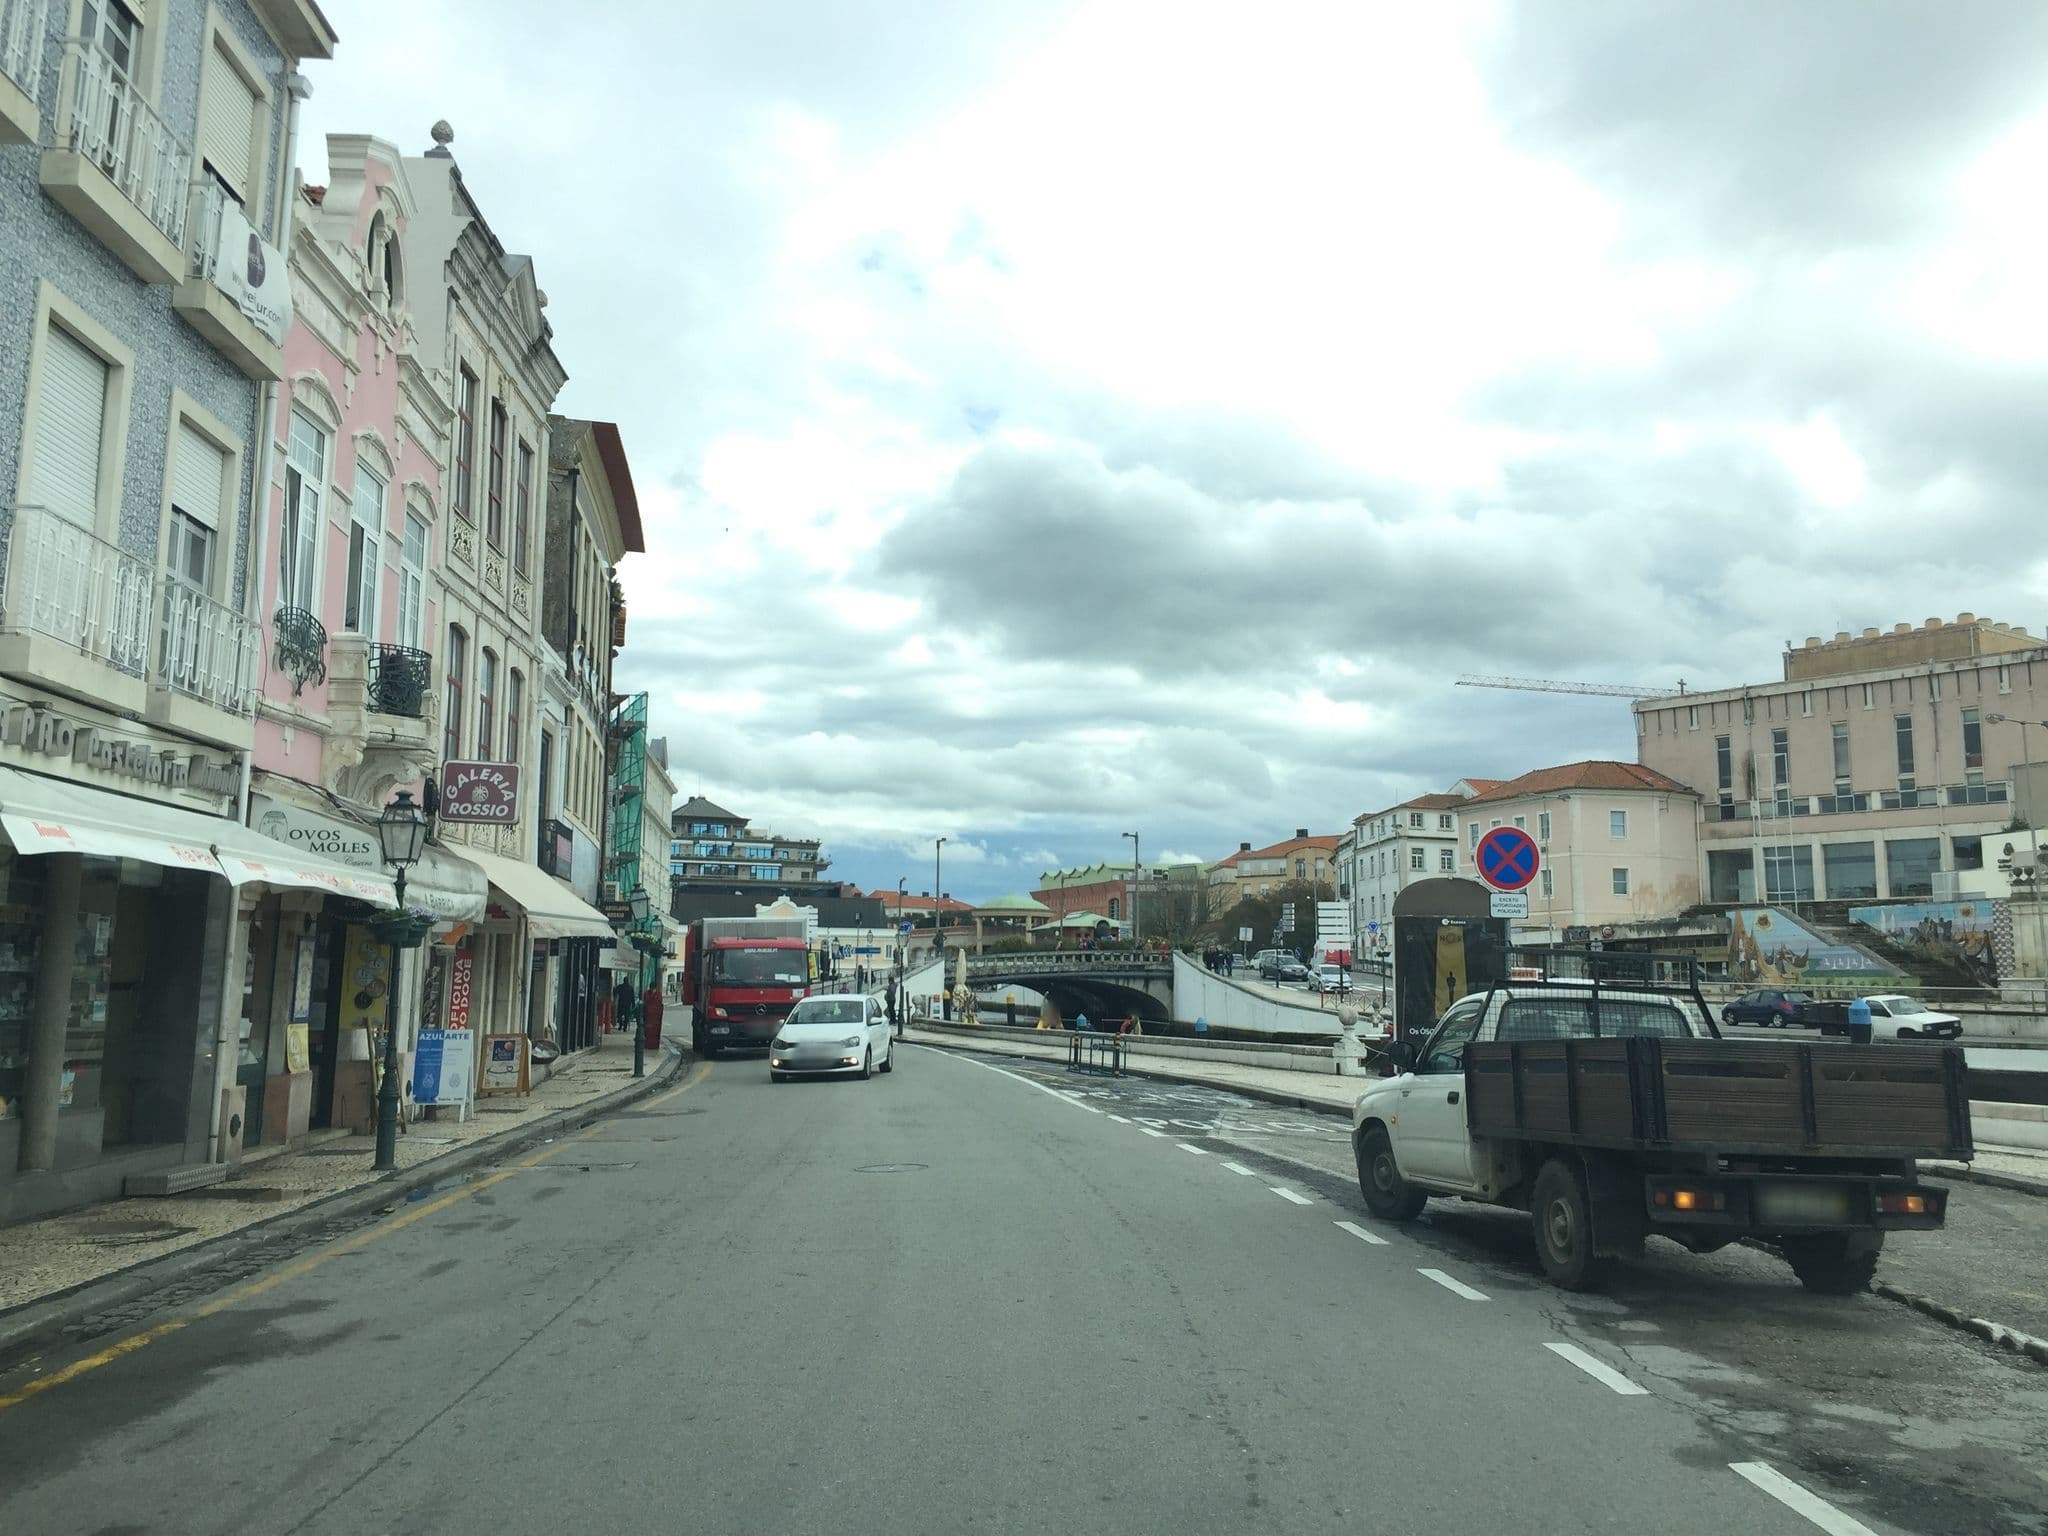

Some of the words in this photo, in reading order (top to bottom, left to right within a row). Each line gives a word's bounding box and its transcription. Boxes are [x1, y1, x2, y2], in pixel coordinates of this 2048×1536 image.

[446, 768, 515, 802] GALERIA
[448, 802, 509, 817] ROSSIO
[289, 829, 341, 841] OVOS
[309, 842, 370, 854] MOLES
[418, 1032, 470, 1041] AZULARTE
